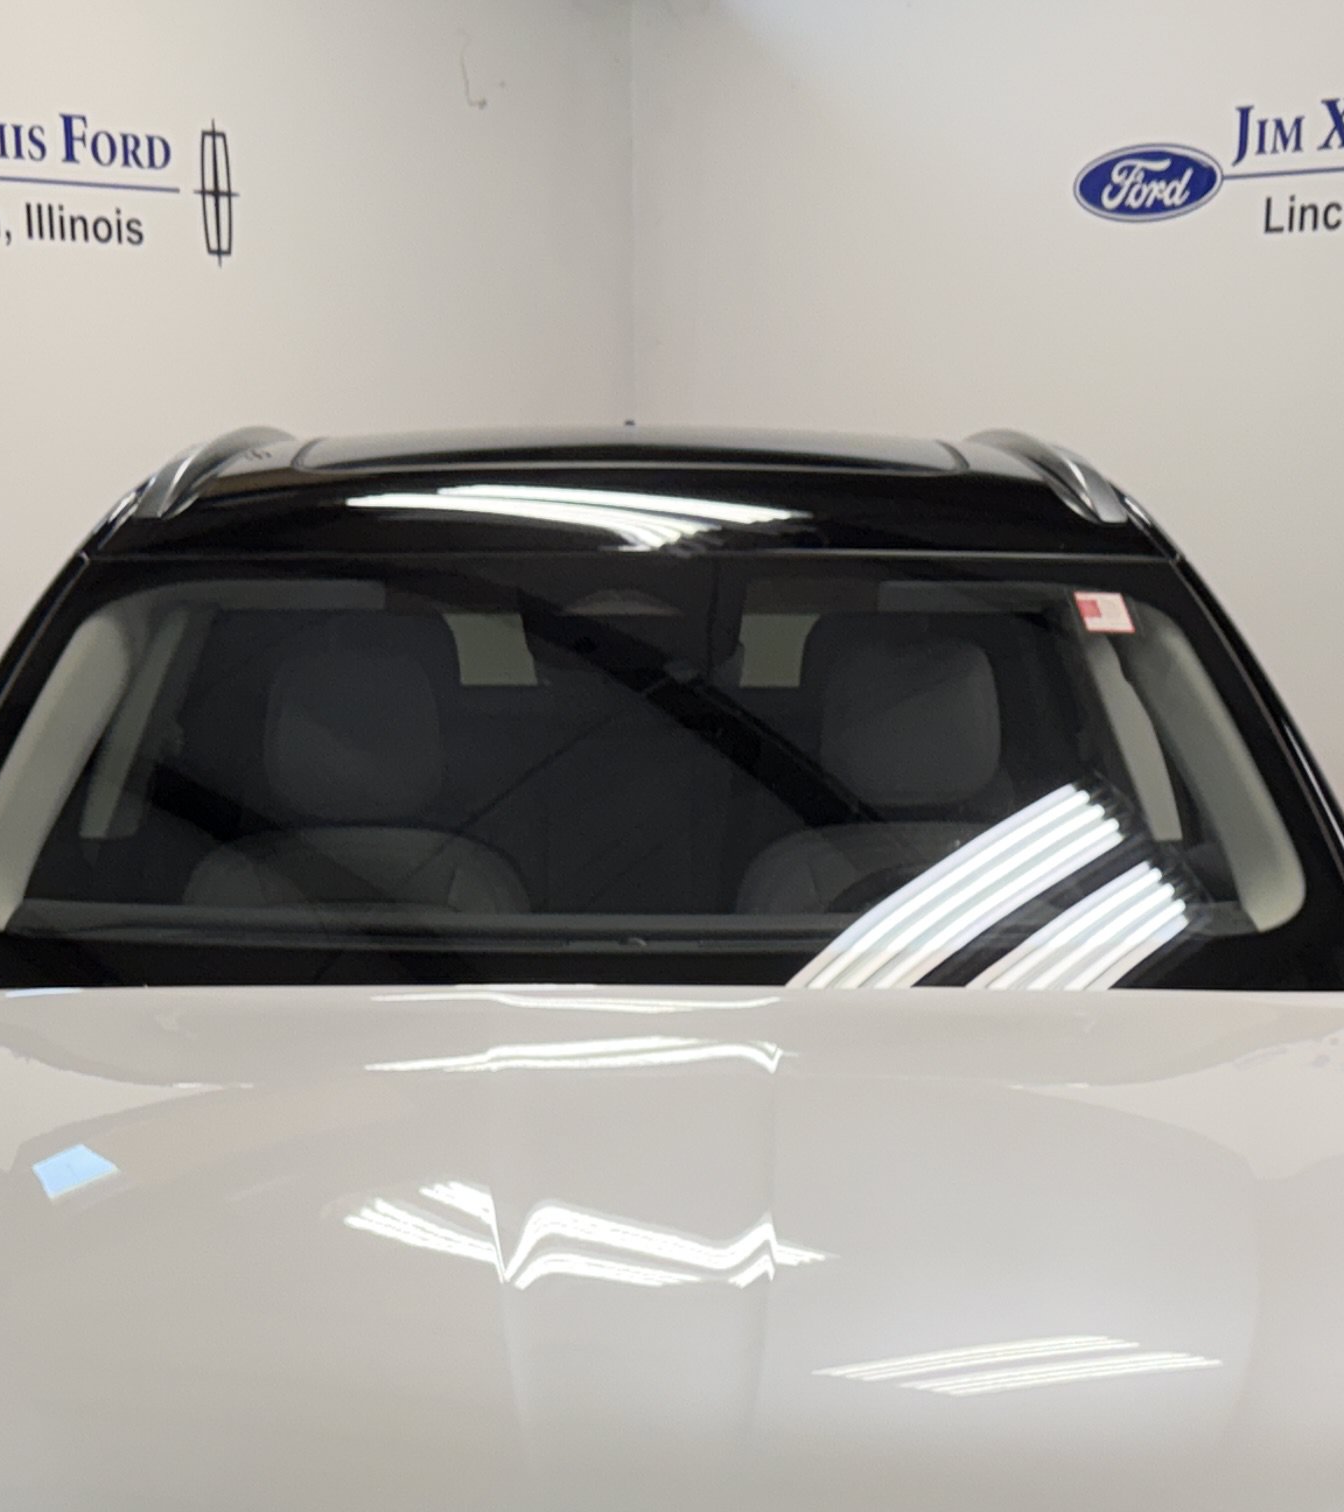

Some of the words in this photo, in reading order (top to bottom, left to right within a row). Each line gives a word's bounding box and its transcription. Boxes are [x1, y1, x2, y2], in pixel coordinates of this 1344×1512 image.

[59, 113, 172, 170] FORD
[1230, 104, 1305, 167] JIM
[1101, 158, 1194, 212] Ford
[25, 202, 145, 246] Illinois
